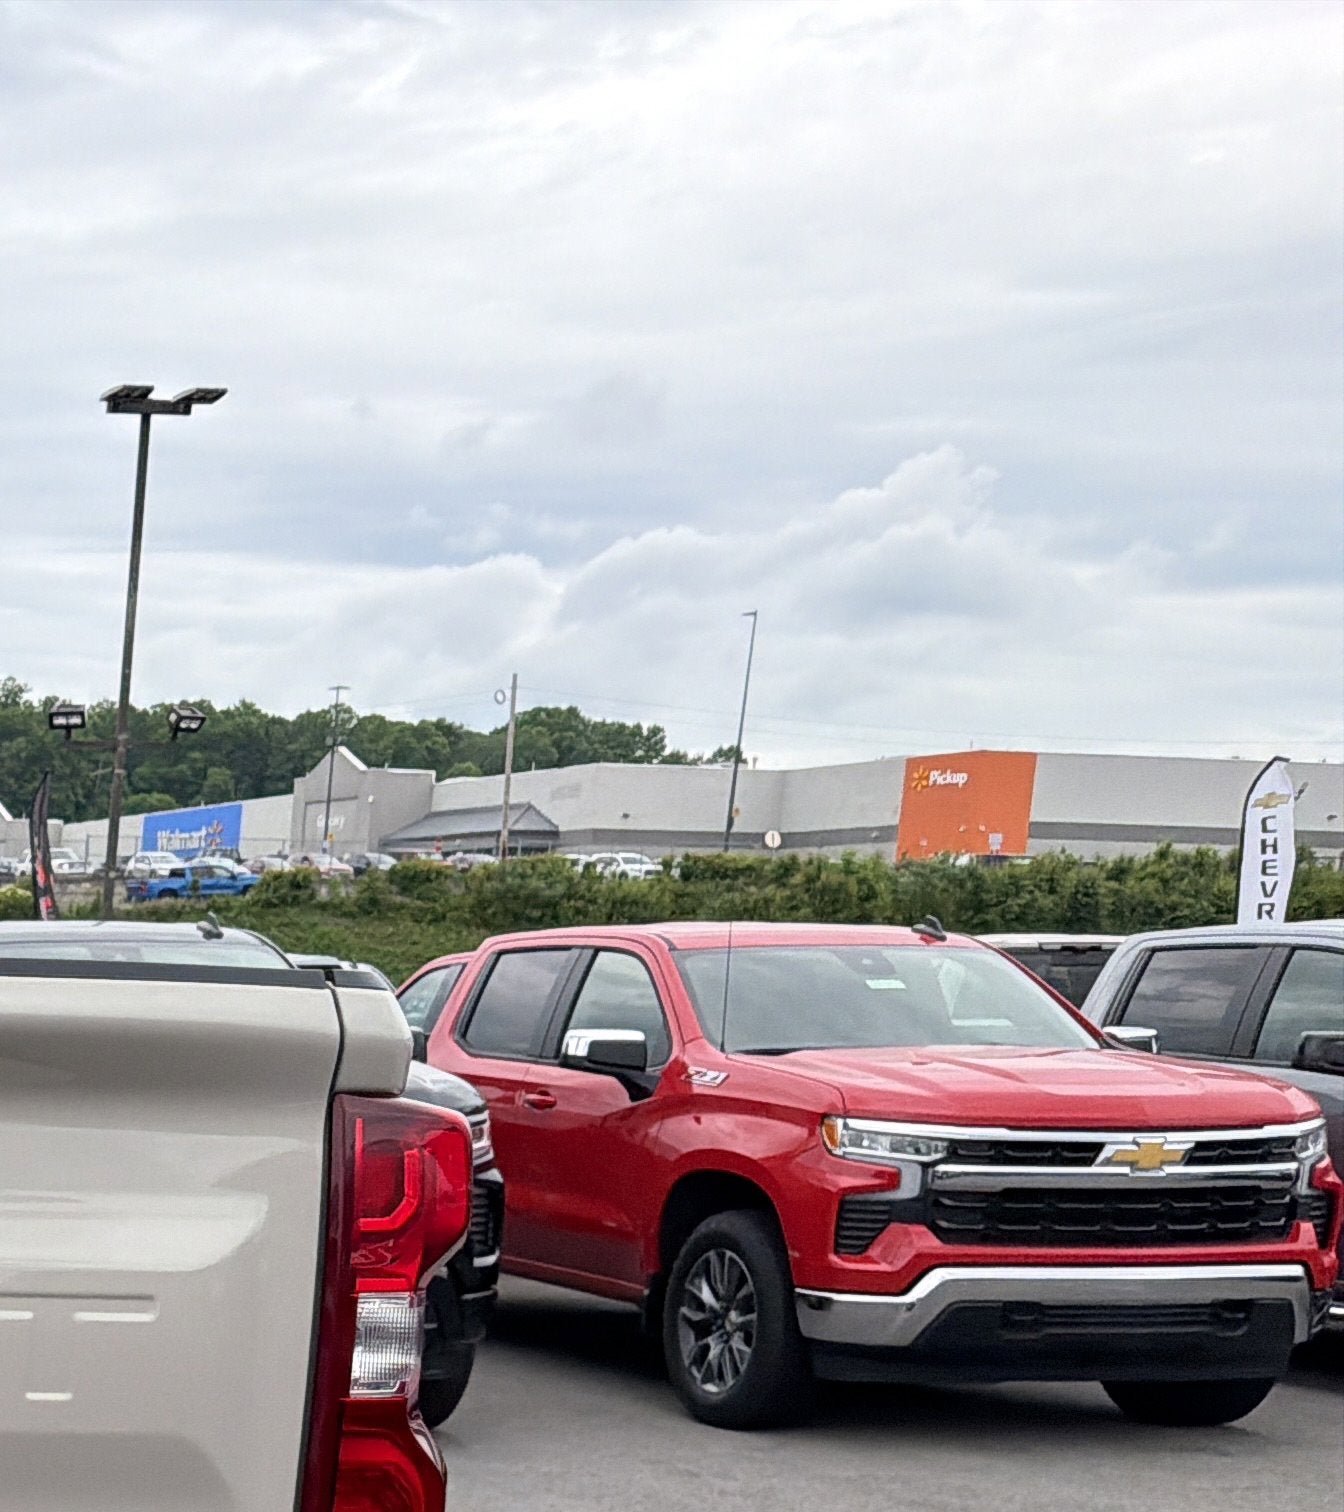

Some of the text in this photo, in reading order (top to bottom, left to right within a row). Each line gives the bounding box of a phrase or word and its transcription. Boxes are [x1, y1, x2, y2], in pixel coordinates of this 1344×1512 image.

[928, 769, 968, 788] Pickup
[157, 825, 206, 853] Walmart
[1257, 815, 1279, 920] CHEVR
